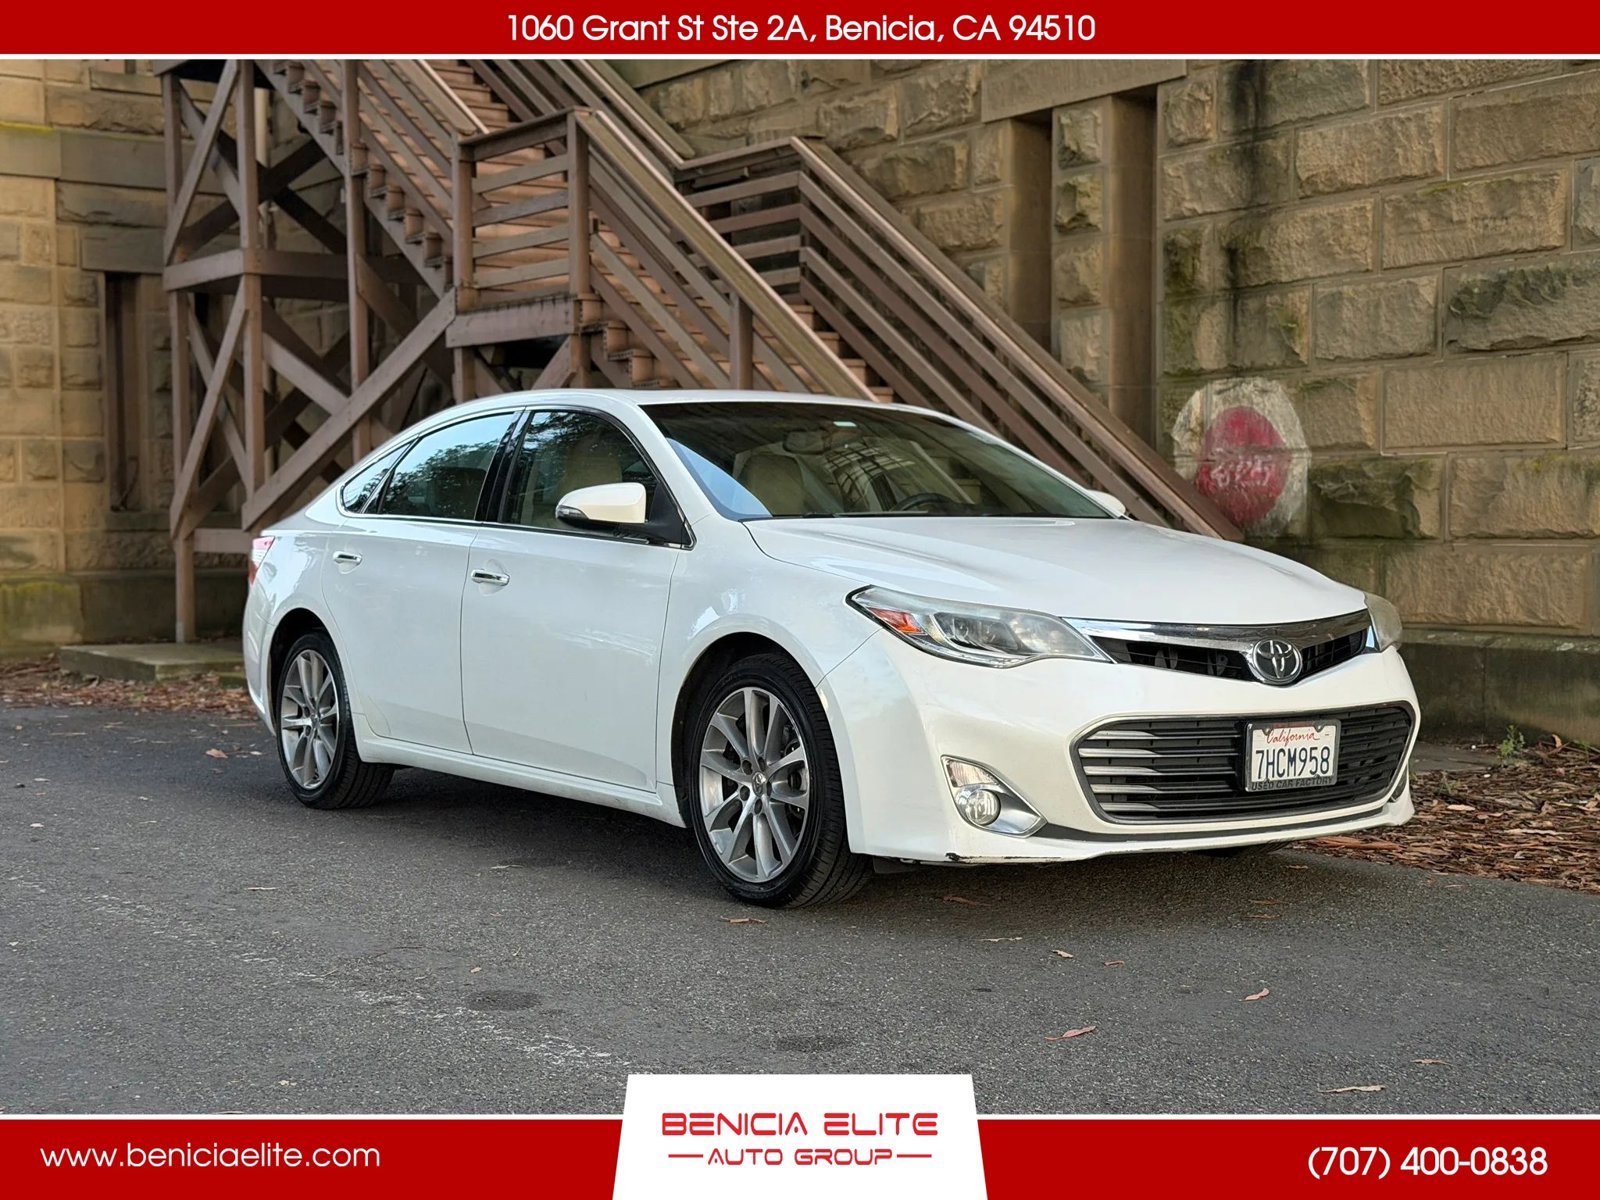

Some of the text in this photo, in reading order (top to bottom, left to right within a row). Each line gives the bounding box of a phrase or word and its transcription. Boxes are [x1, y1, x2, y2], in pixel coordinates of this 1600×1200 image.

[1266, 729, 1320, 747] California
[1255, 746, 1331, 779] 7HCM958
[1251, 777, 1333, 791] USED CAR FACTORY
